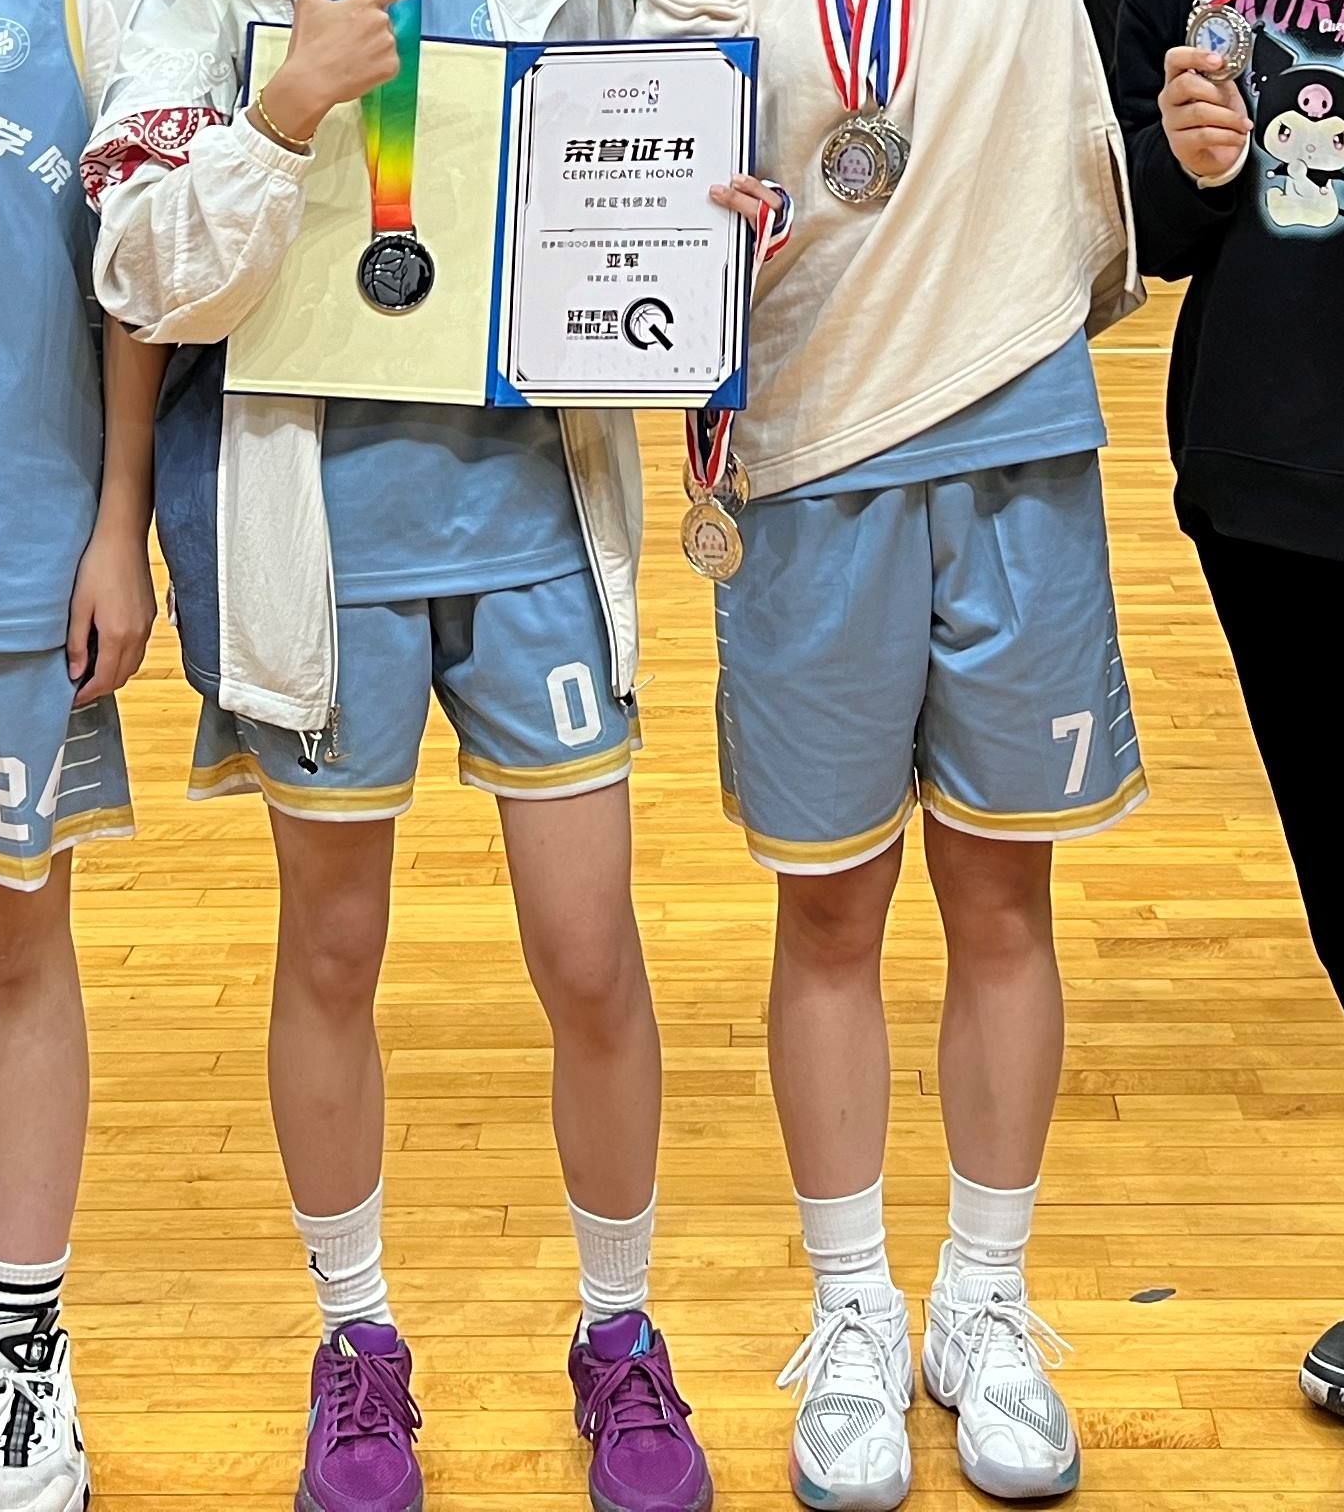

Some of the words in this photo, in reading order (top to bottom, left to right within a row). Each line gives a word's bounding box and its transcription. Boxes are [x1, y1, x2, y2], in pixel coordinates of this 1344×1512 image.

[564, 137, 695, 163] 荣誉证书
[563, 169, 641, 180] CERTIFICATE
[645, 168, 694, 179] HONOR
[606, 253, 639, 268] 亚军
[546, 662, 602, 746] 0
[1052, 710, 1094, 795] 7
